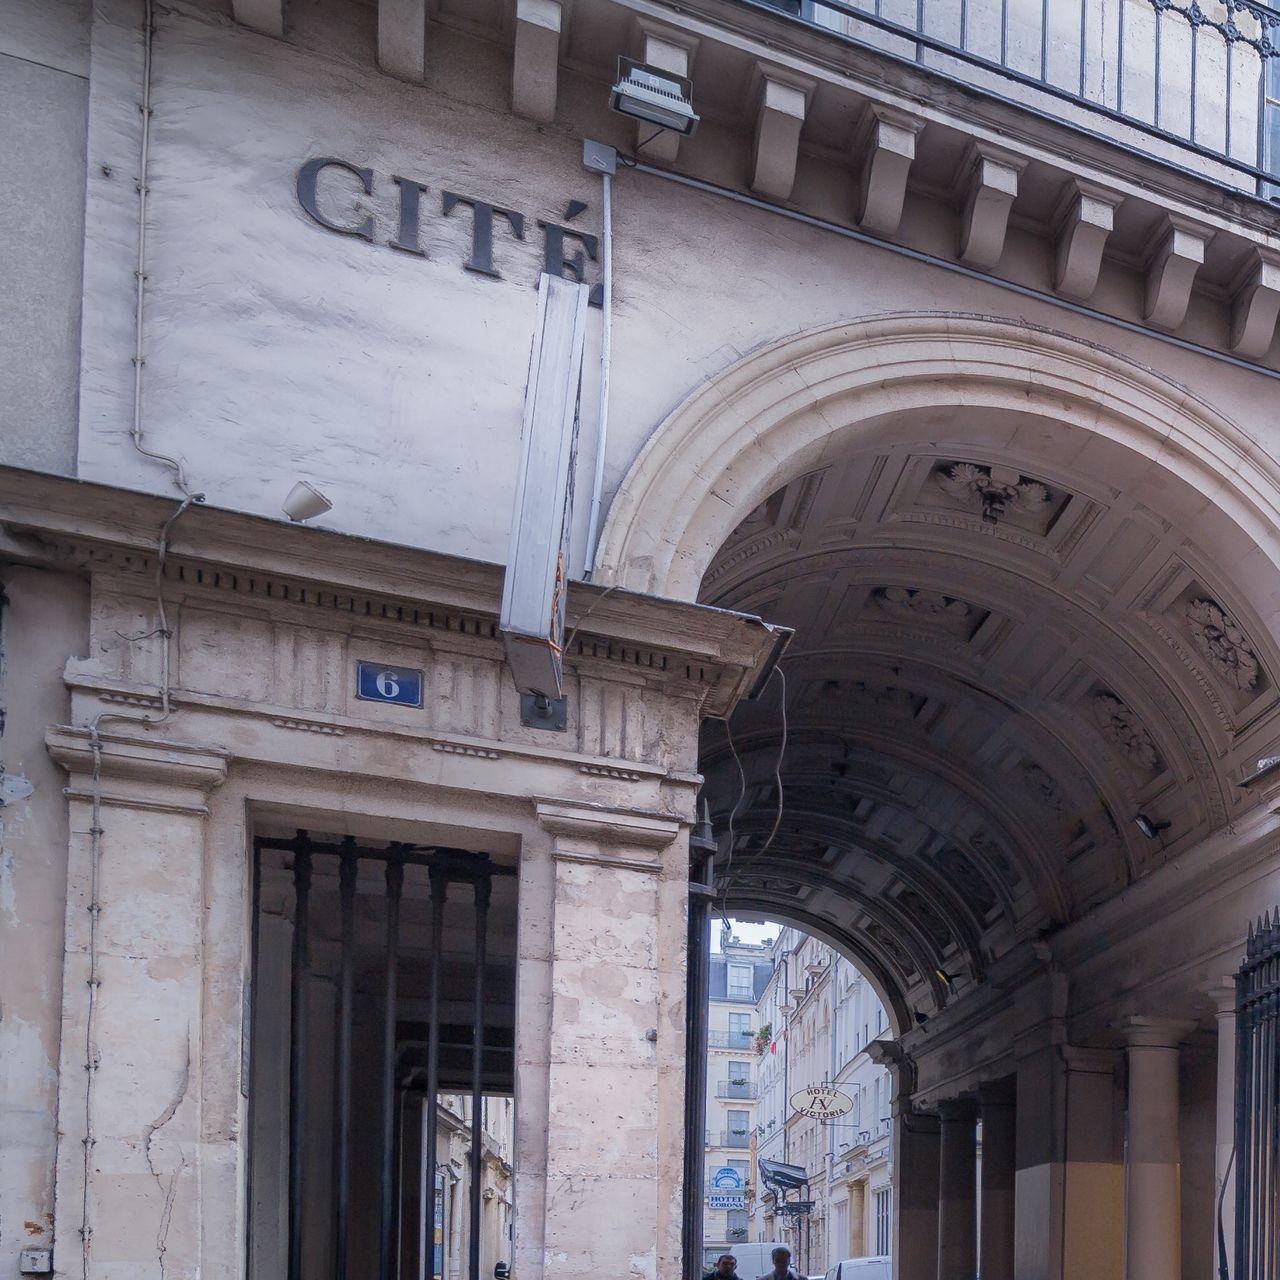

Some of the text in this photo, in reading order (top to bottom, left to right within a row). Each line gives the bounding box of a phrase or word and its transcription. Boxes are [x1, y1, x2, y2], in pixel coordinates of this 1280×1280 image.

[296, 155, 606, 309] CITÉ
[377, 670, 400, 699] 6
[806, 1088, 838, 1099] HOTEL
[800, 1106, 845, 1118] VICTORIA
